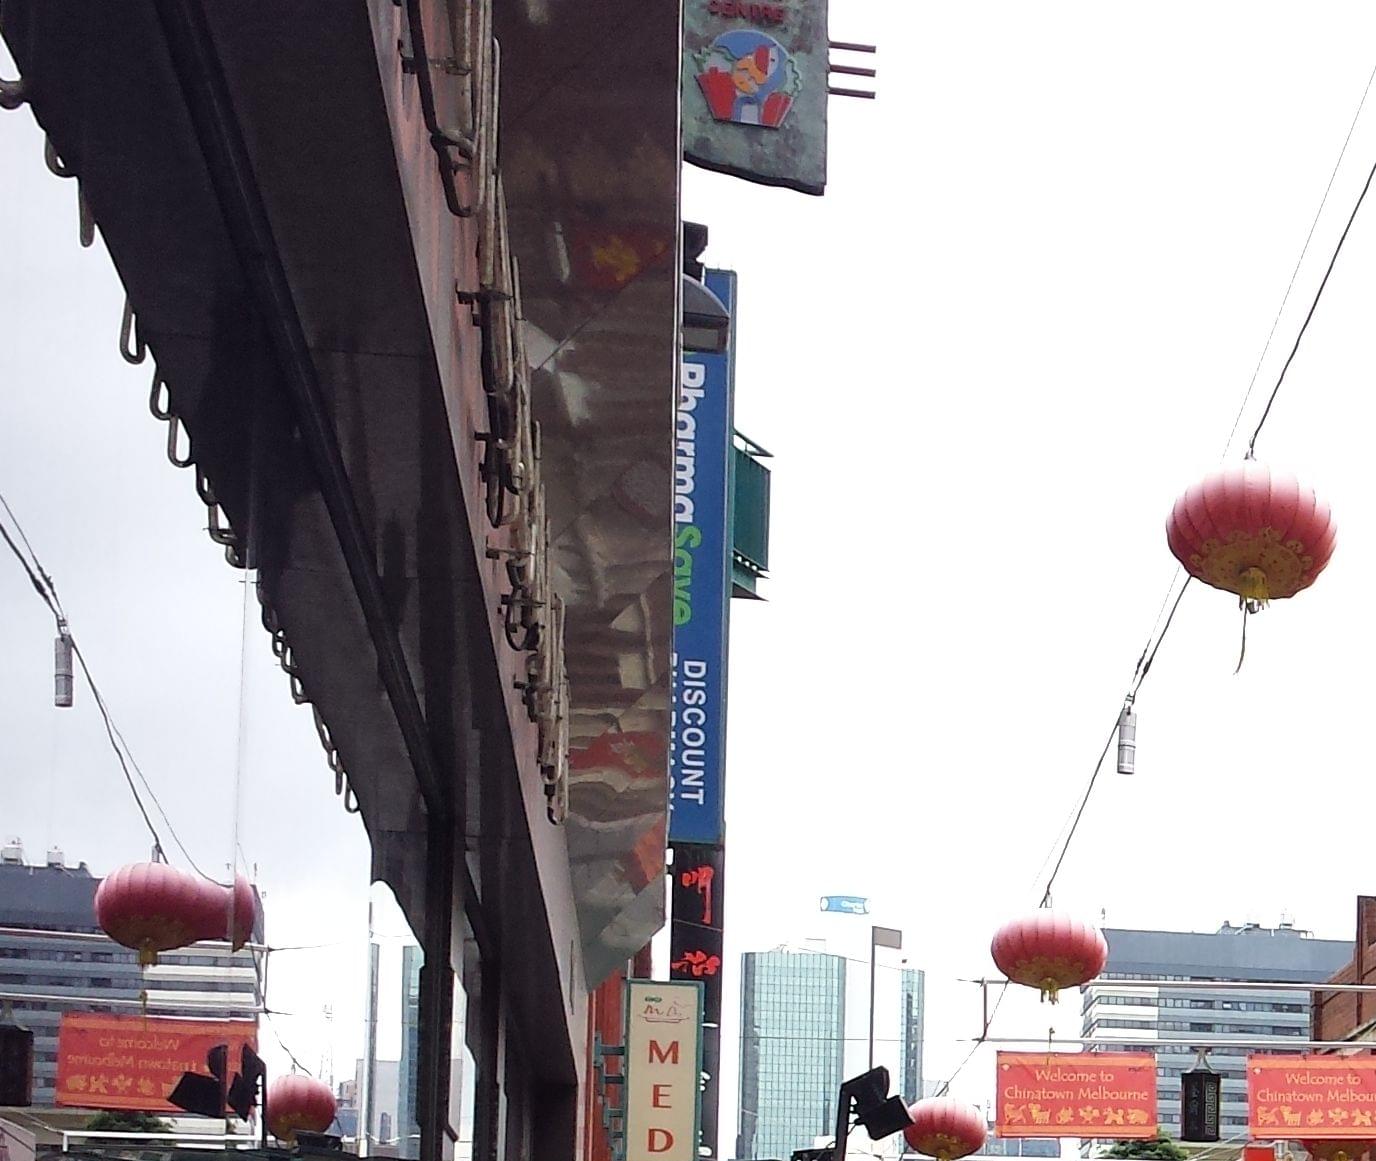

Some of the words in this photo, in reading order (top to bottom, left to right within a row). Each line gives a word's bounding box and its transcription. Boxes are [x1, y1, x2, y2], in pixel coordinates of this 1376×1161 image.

[680, 660, 707, 806] DISCOUNT
[1035, 1068, 1097, 1083] Welcome
[1100, 1069, 1114, 1083] to
[1285, 1070, 1344, 1085] Welcome
[1346, 1072, 1361, 1085] to
[1004, 1085, 1074, 1101] Chinatown
[1077, 1085, 1149, 1101] Melbourne
[1256, 1088, 1323, 1103] Chinatown
